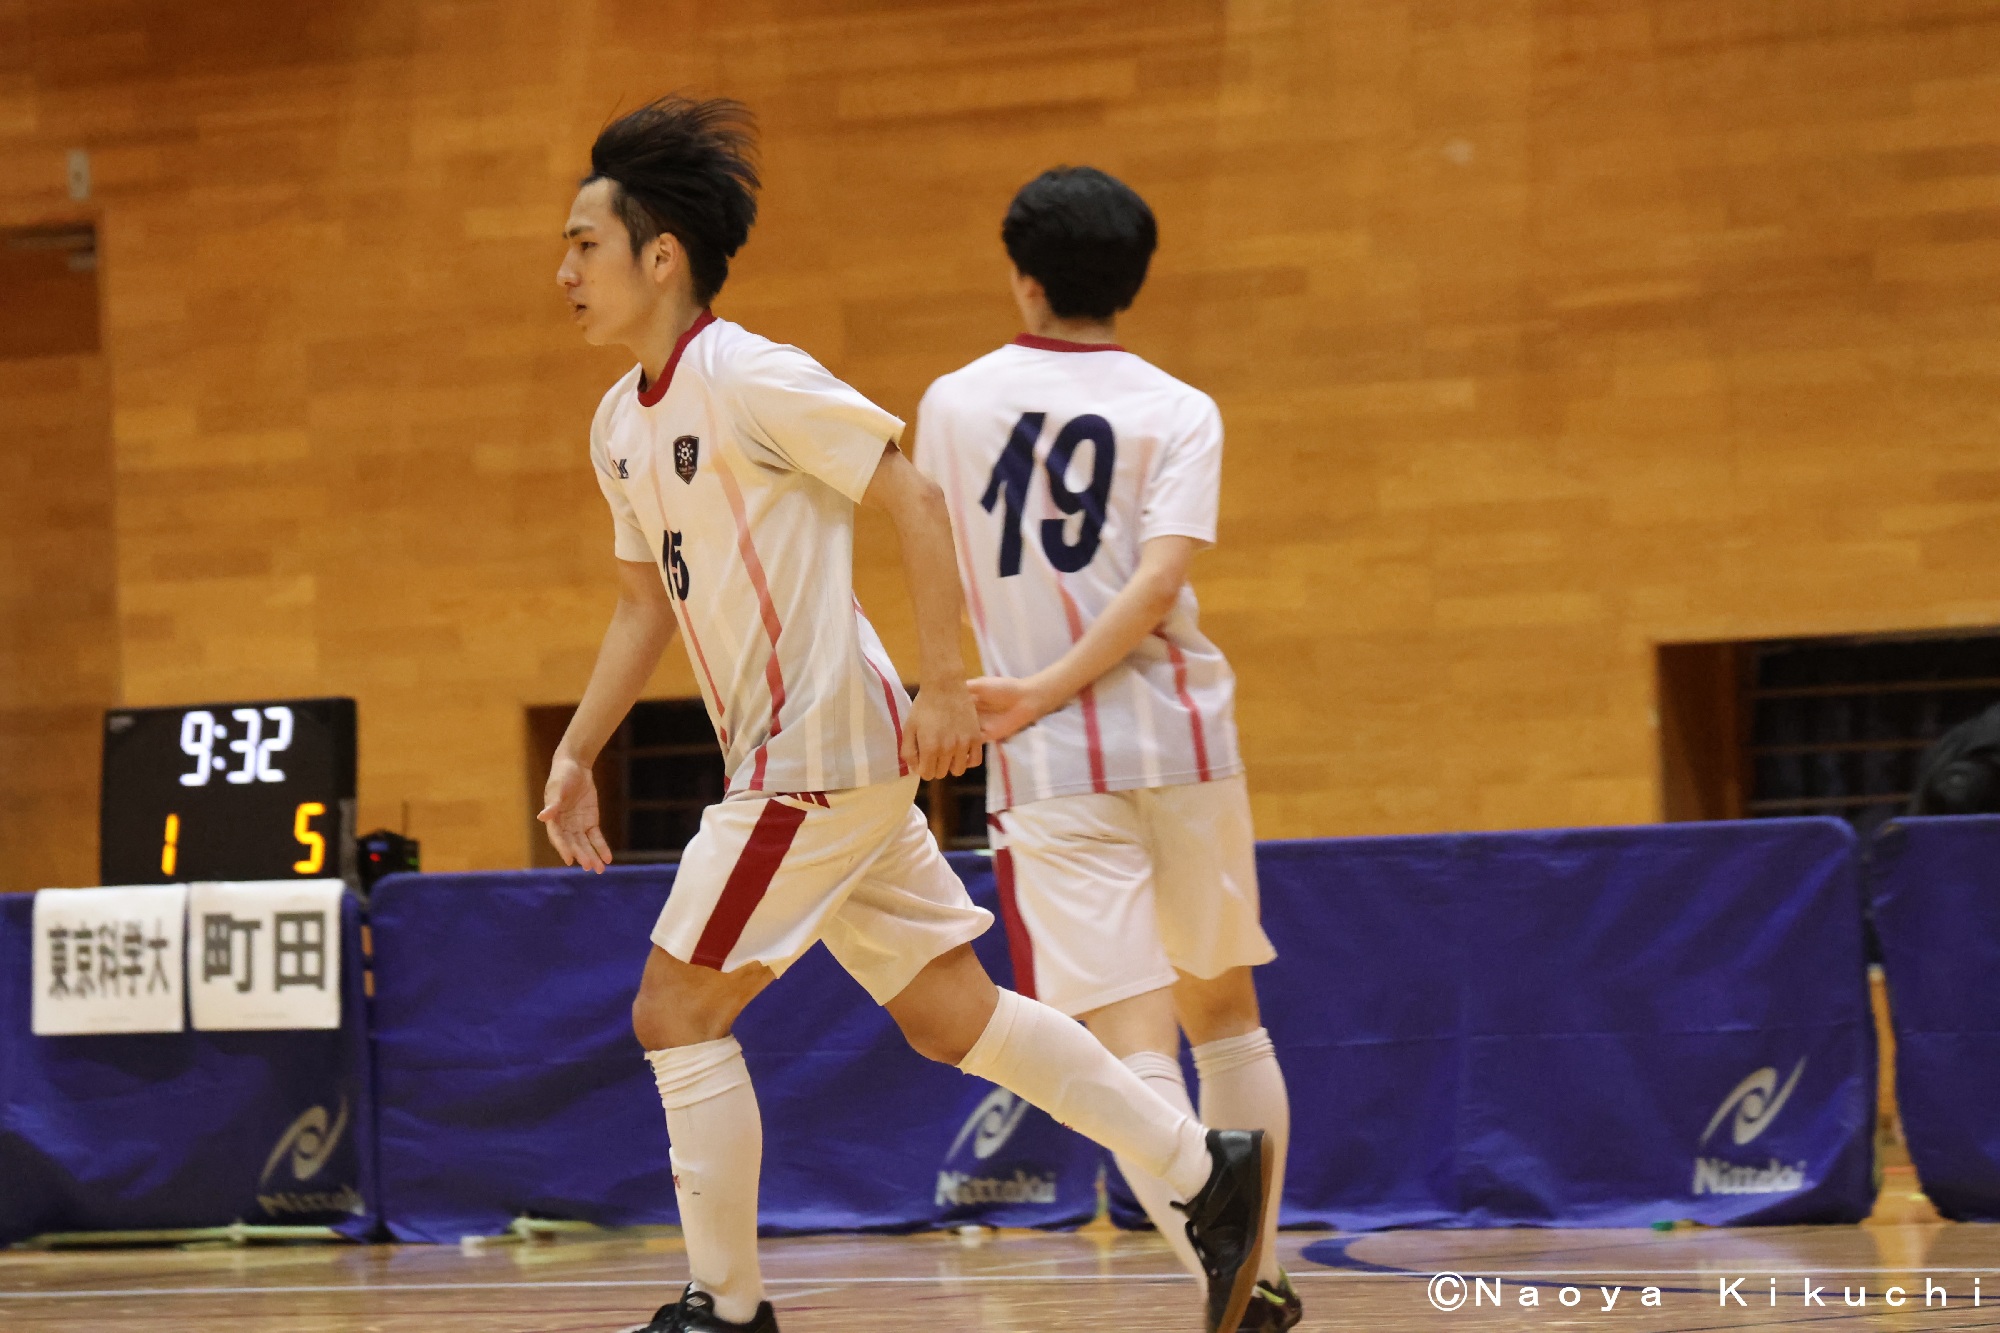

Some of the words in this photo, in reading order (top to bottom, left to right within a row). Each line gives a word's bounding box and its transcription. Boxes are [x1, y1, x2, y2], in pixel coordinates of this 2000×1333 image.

[979, 411, 1117, 578] 19
[662, 529, 690, 601] 15
[179, 706, 294, 787] 9:32
[161, 813, 180, 876] 1
[293, 802, 326, 874] 5
[202, 911, 327, 993] 町田
